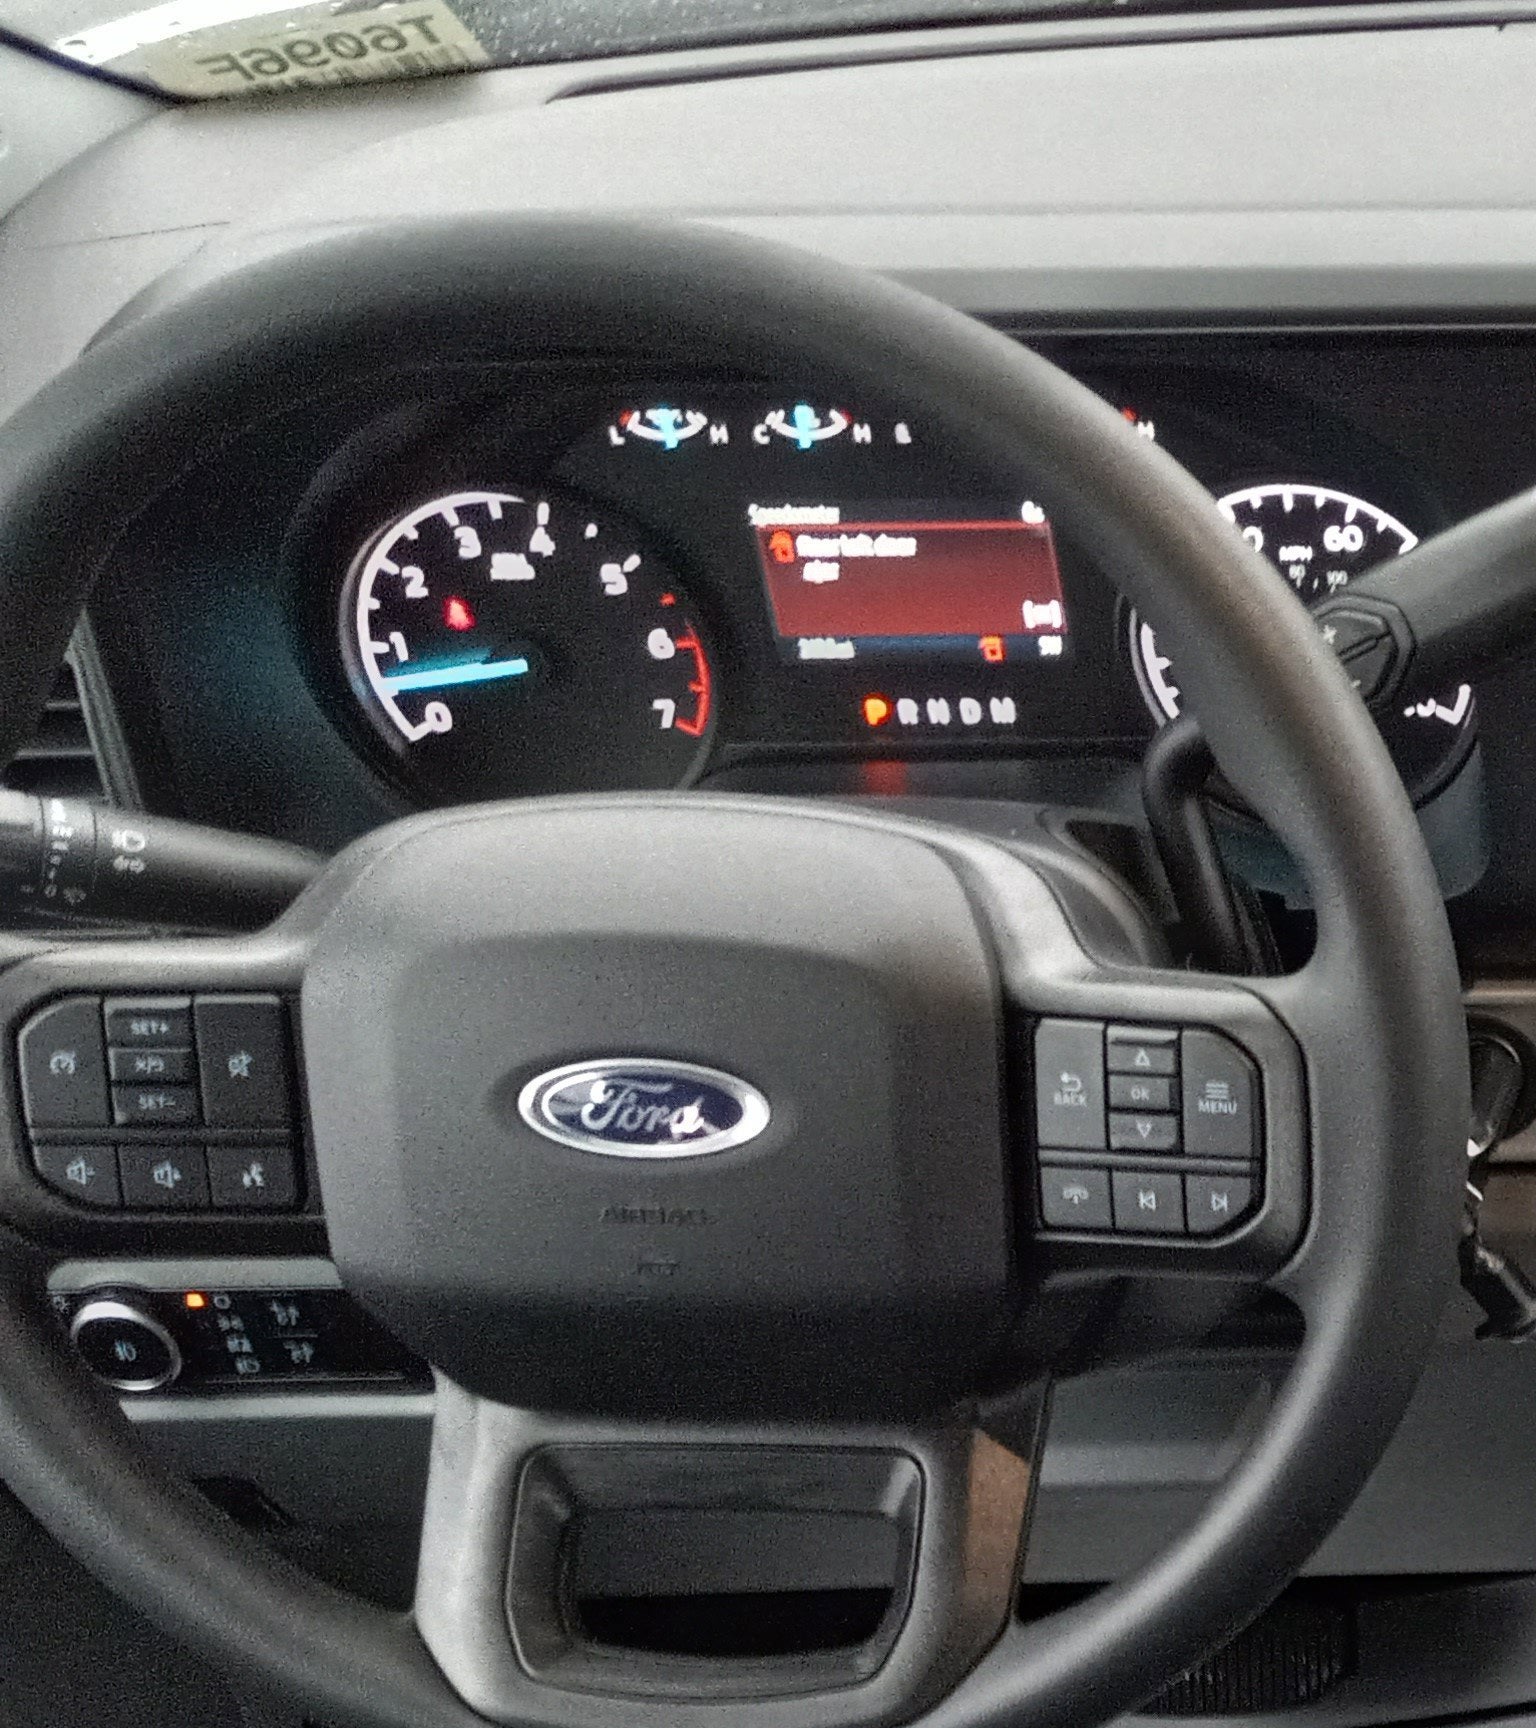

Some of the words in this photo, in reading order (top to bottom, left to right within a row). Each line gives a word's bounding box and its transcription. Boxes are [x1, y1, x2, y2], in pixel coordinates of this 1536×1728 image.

[608, 425, 625, 446] L
[753, 424, 770, 444] C
[455, 526, 481, 558] 3
[529, 526, 556, 556] 4
[1323, 525, 1363, 552] 60
[402, 566, 428, 597] 2
[600, 563, 628, 595] 5
[389, 631, 409, 660] 1
[648, 628, 675, 659] 6
[425, 701, 452, 732] 0
[652, 698, 675, 728] 7
[865, 698, 887, 726] P
[898, 697, 918, 724] R
[960, 697, 981, 724] D
[581, 1078, 705, 1134] Ford
[1053, 1092, 1087, 1107] BACK
[1131, 1086, 1150, 1101] OK
[1198, 1100, 1237, 1115] MENU
